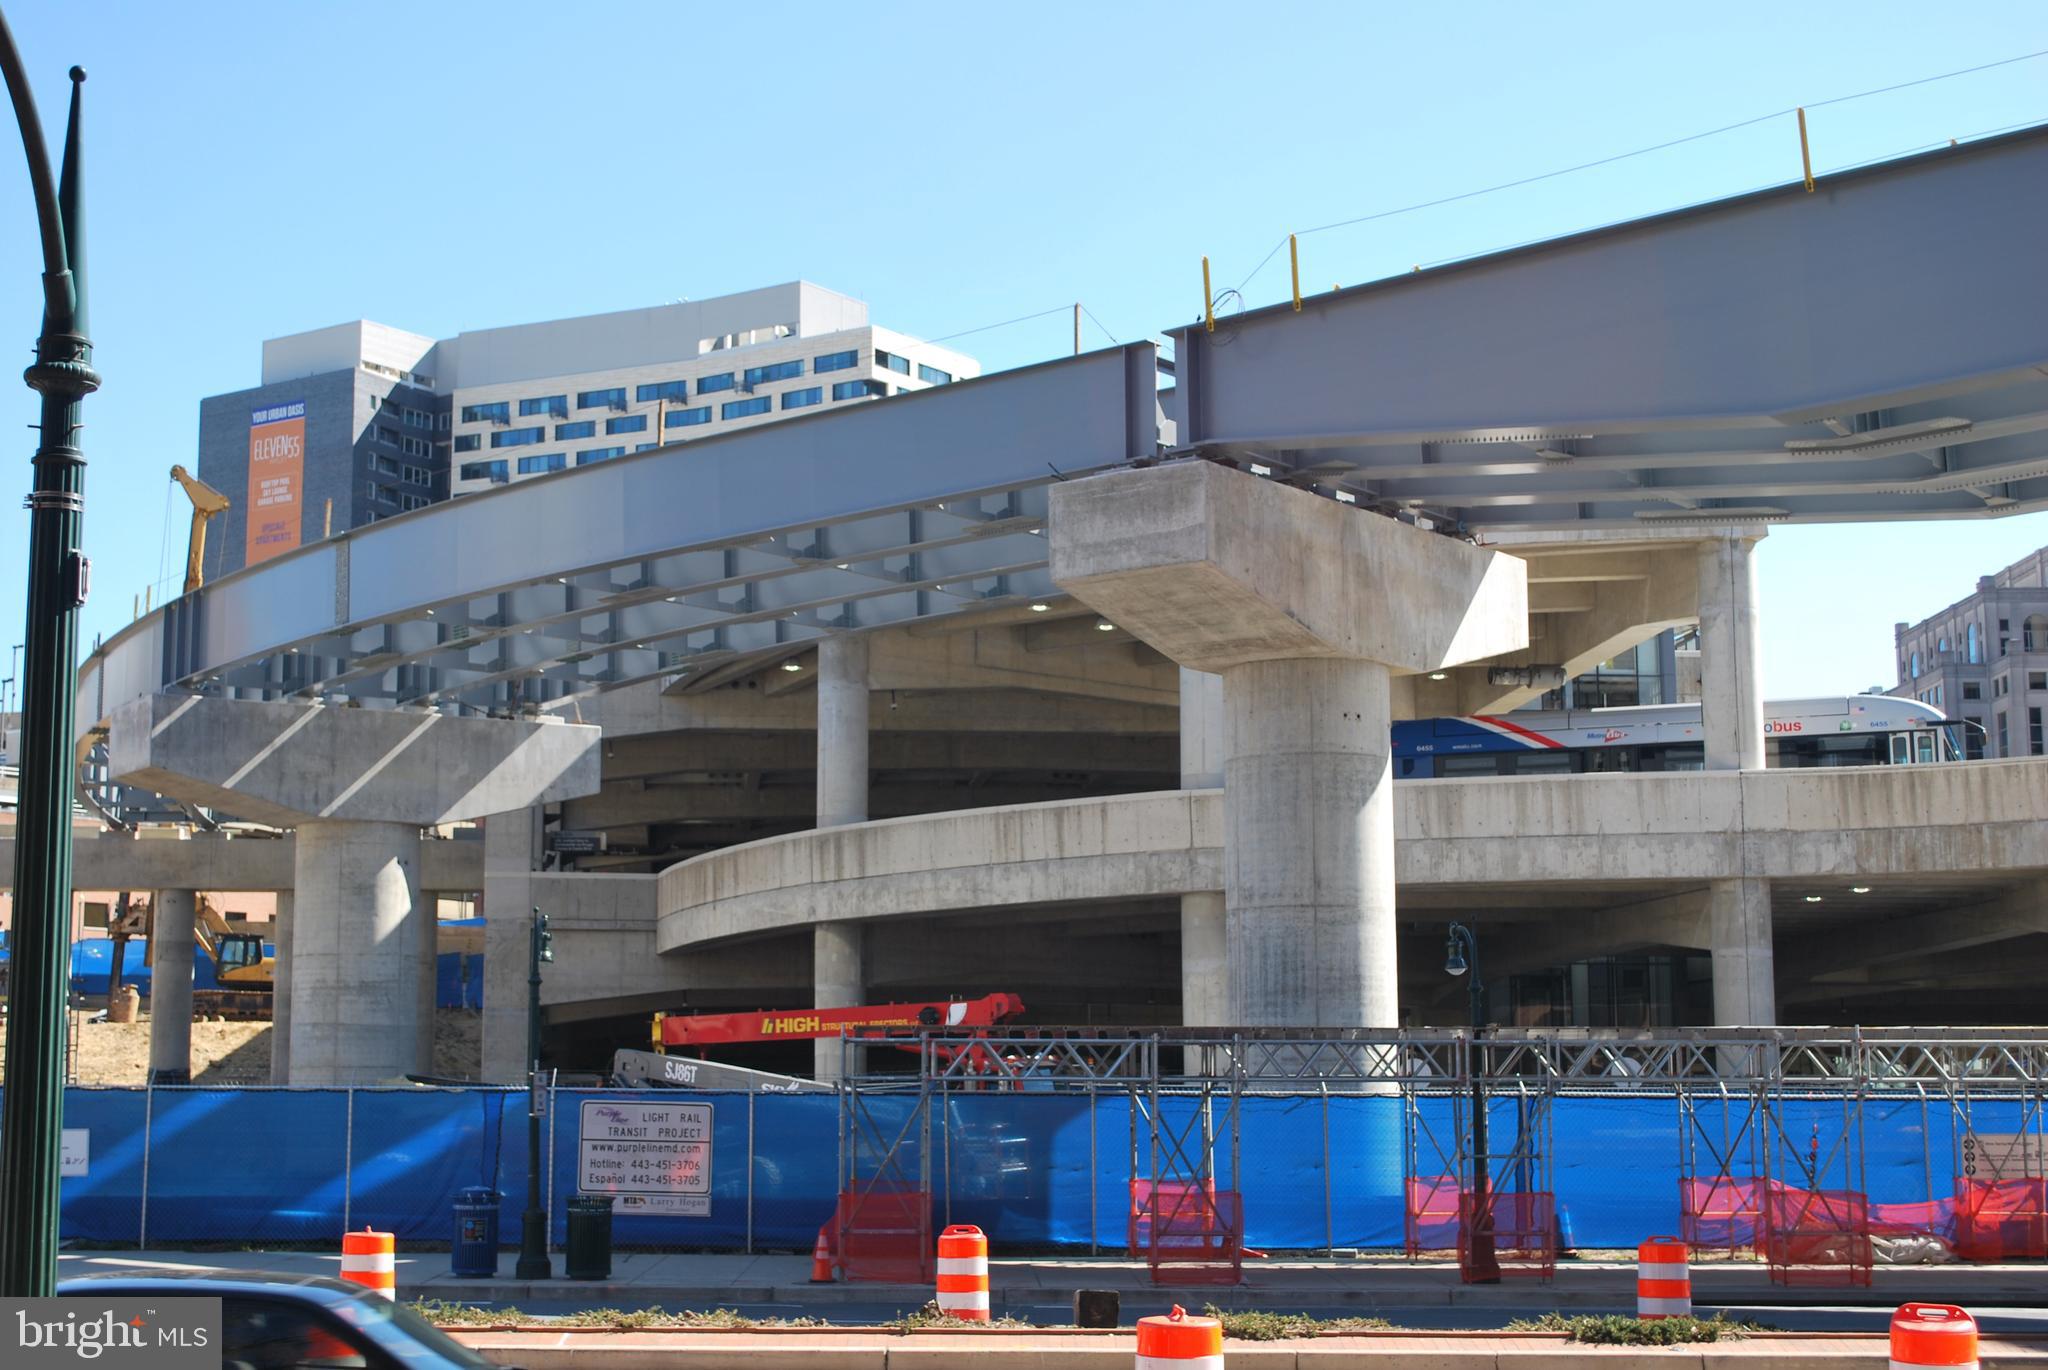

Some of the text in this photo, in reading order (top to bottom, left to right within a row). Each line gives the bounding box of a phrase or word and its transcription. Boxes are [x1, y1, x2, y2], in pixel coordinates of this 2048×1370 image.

[252, 403, 305, 424] YOUR URBAN OASIS
[775, 1016, 819, 1034] HIGH
[665, 1061, 698, 1084] SJ86T
[642, 1112, 702, 1124] LIGHT RAIL
[608, 1126, 702, 1138] TRANSIT PROJECT
[591, 1143, 701, 1154] www.purplelinemd.com
[590, 1158, 701, 1170] Hotline: 443-451-3706
[589, 1173, 701, 1185] Español 443-451-3705
[650, 1198, 675, 1207] Larry
[679, 1198, 706, 1207] Hogan
